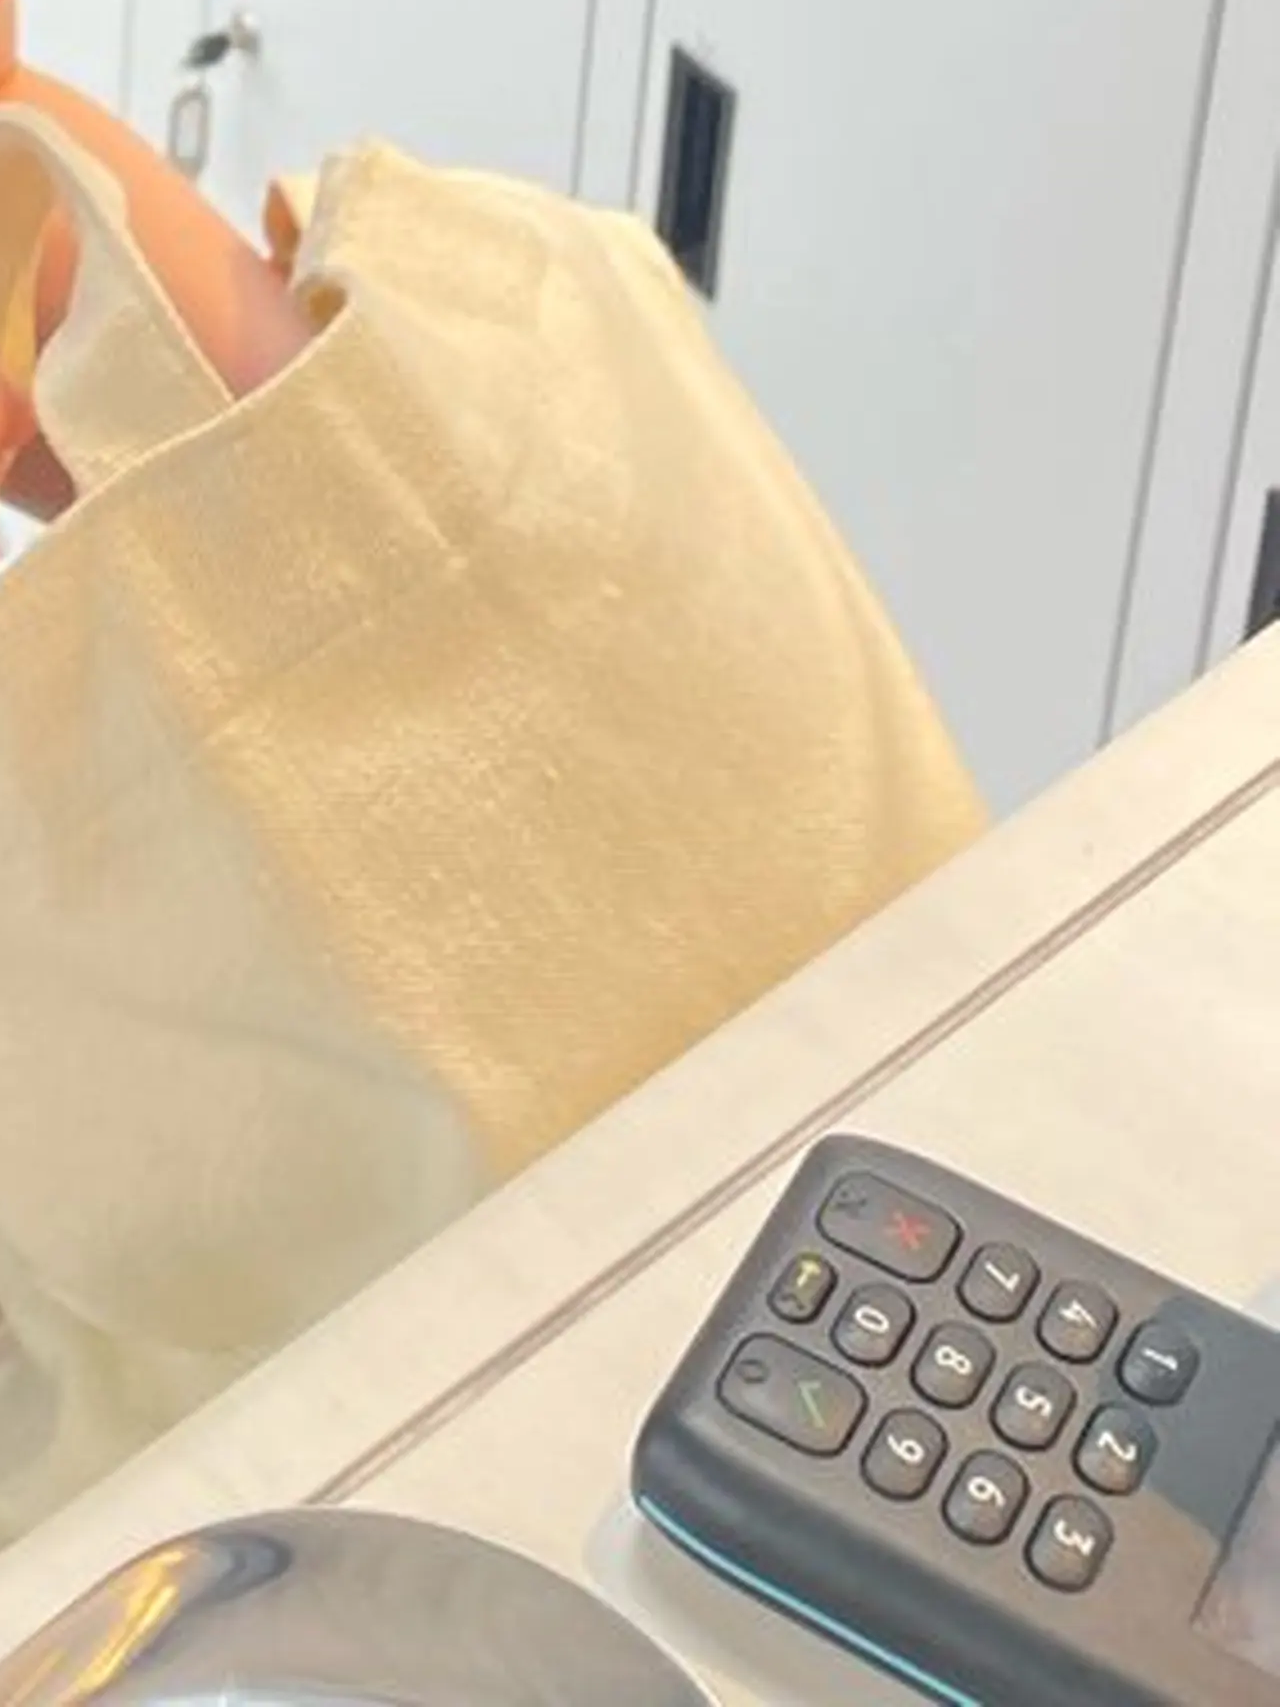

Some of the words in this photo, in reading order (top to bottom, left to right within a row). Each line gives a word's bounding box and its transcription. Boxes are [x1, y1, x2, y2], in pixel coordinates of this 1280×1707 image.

[984, 1260, 1020, 1292] 7
[854, 1304, 890, 1334] 0
[1059, 1299, 1098, 1328] 4
[934, 1344, 972, 1376] 8
[1141, 1347, 1179, 1371] 1
[1014, 1385, 1053, 1418] 5
[887, 1434, 925, 1465] 9
[1096, 1431, 1137, 1462] 2
[967, 1475, 1006, 1508] 6
[1053, 1518, 1097, 1557] 3
